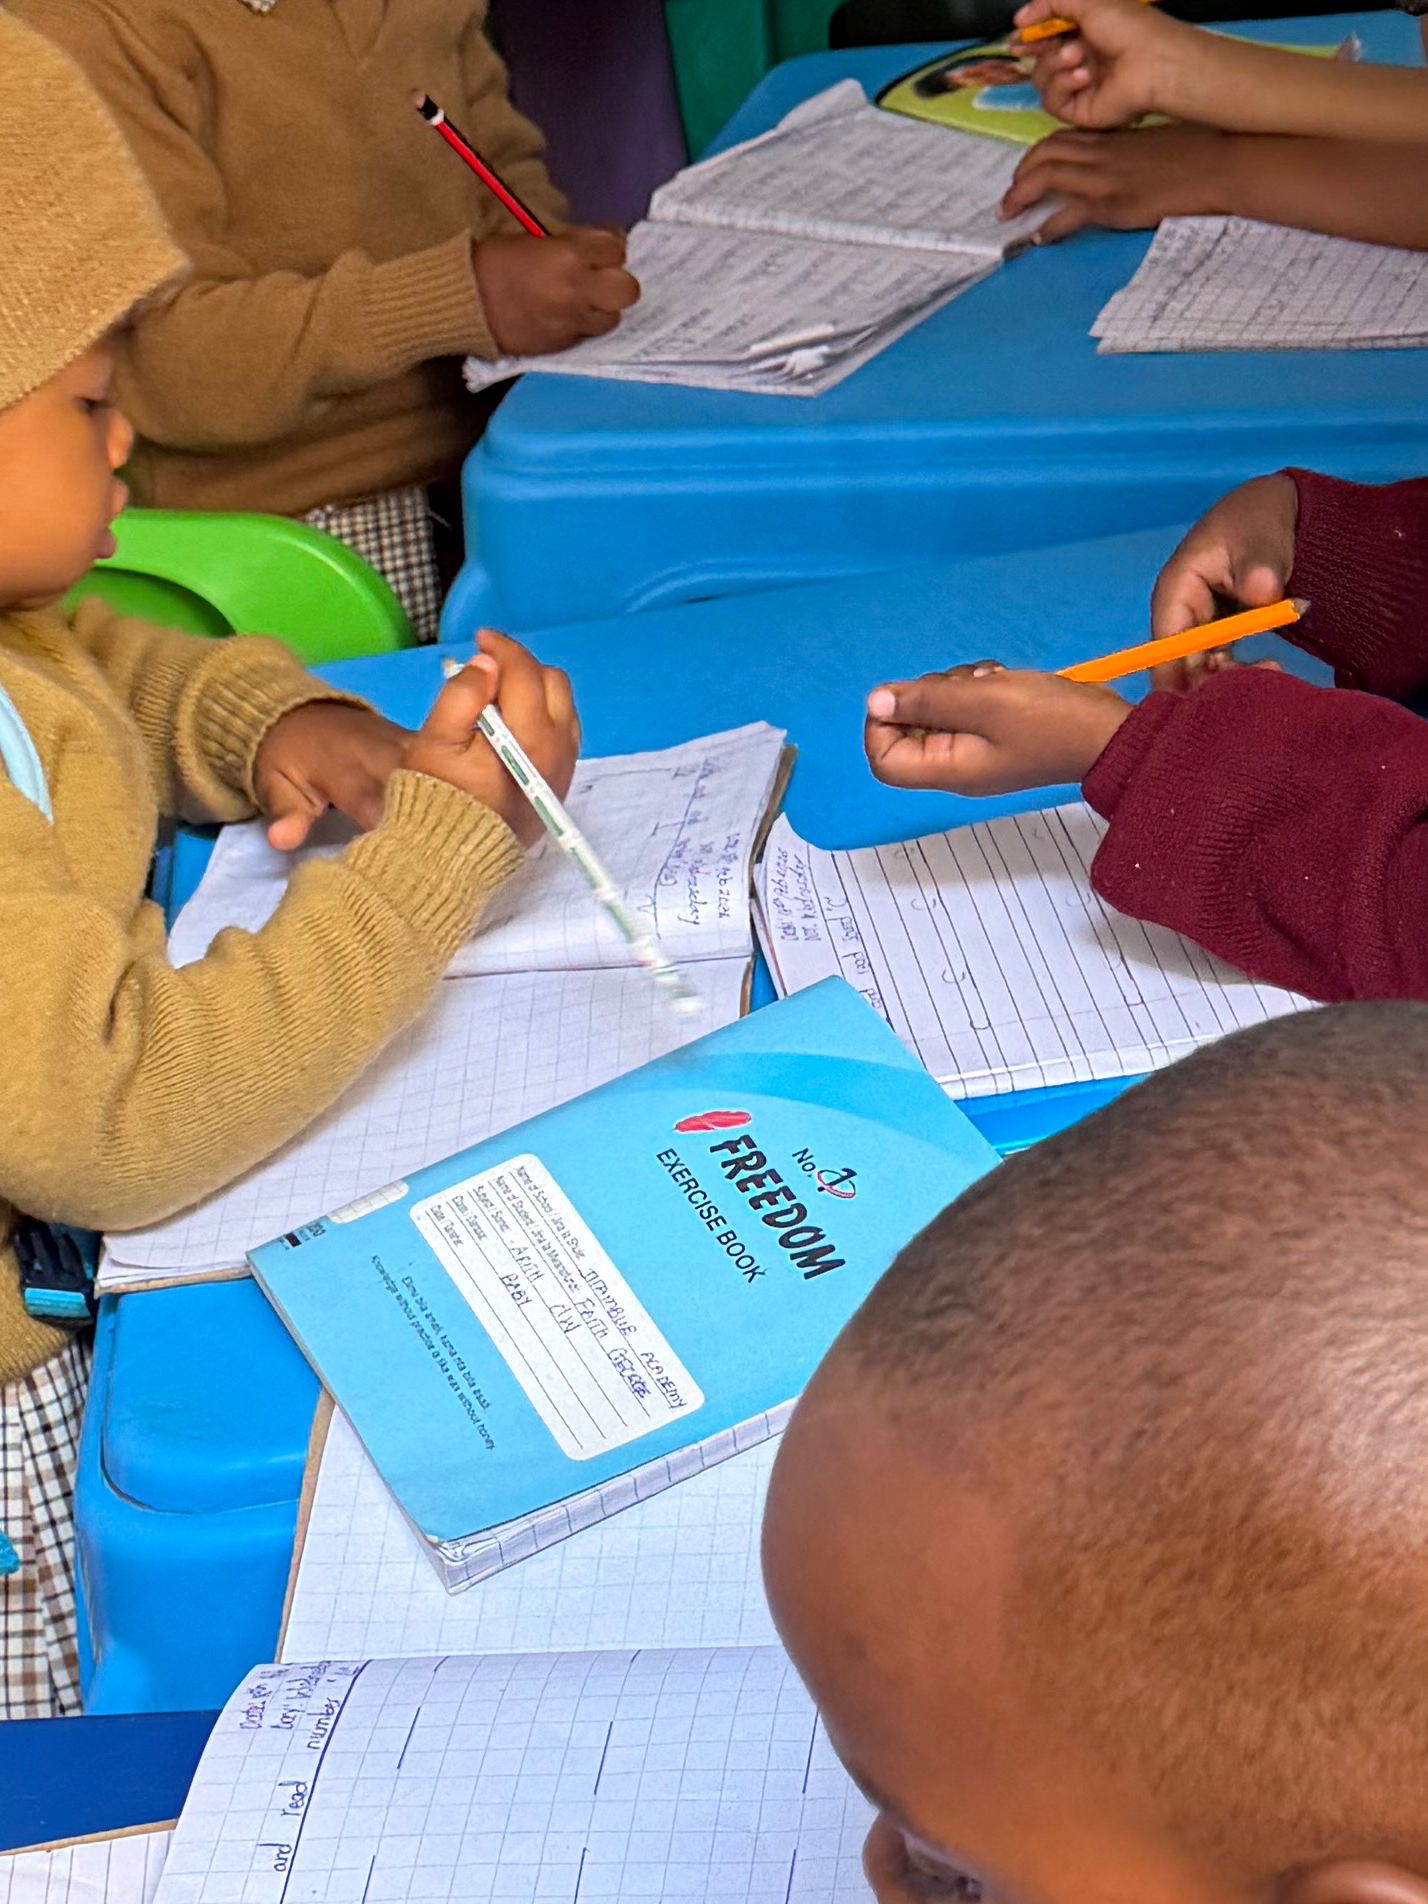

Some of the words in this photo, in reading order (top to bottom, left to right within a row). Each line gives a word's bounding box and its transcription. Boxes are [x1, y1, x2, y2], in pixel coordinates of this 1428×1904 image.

[655, 1147, 727, 1230] EXERCISE
[715, 1229, 766, 1284] BOOK
[707, 1131, 846, 1281] FREEDOM
[499, 1271, 533, 1308] BABY
[257, 1844, 293, 1872] and
[278, 1782, 307, 1816] read
